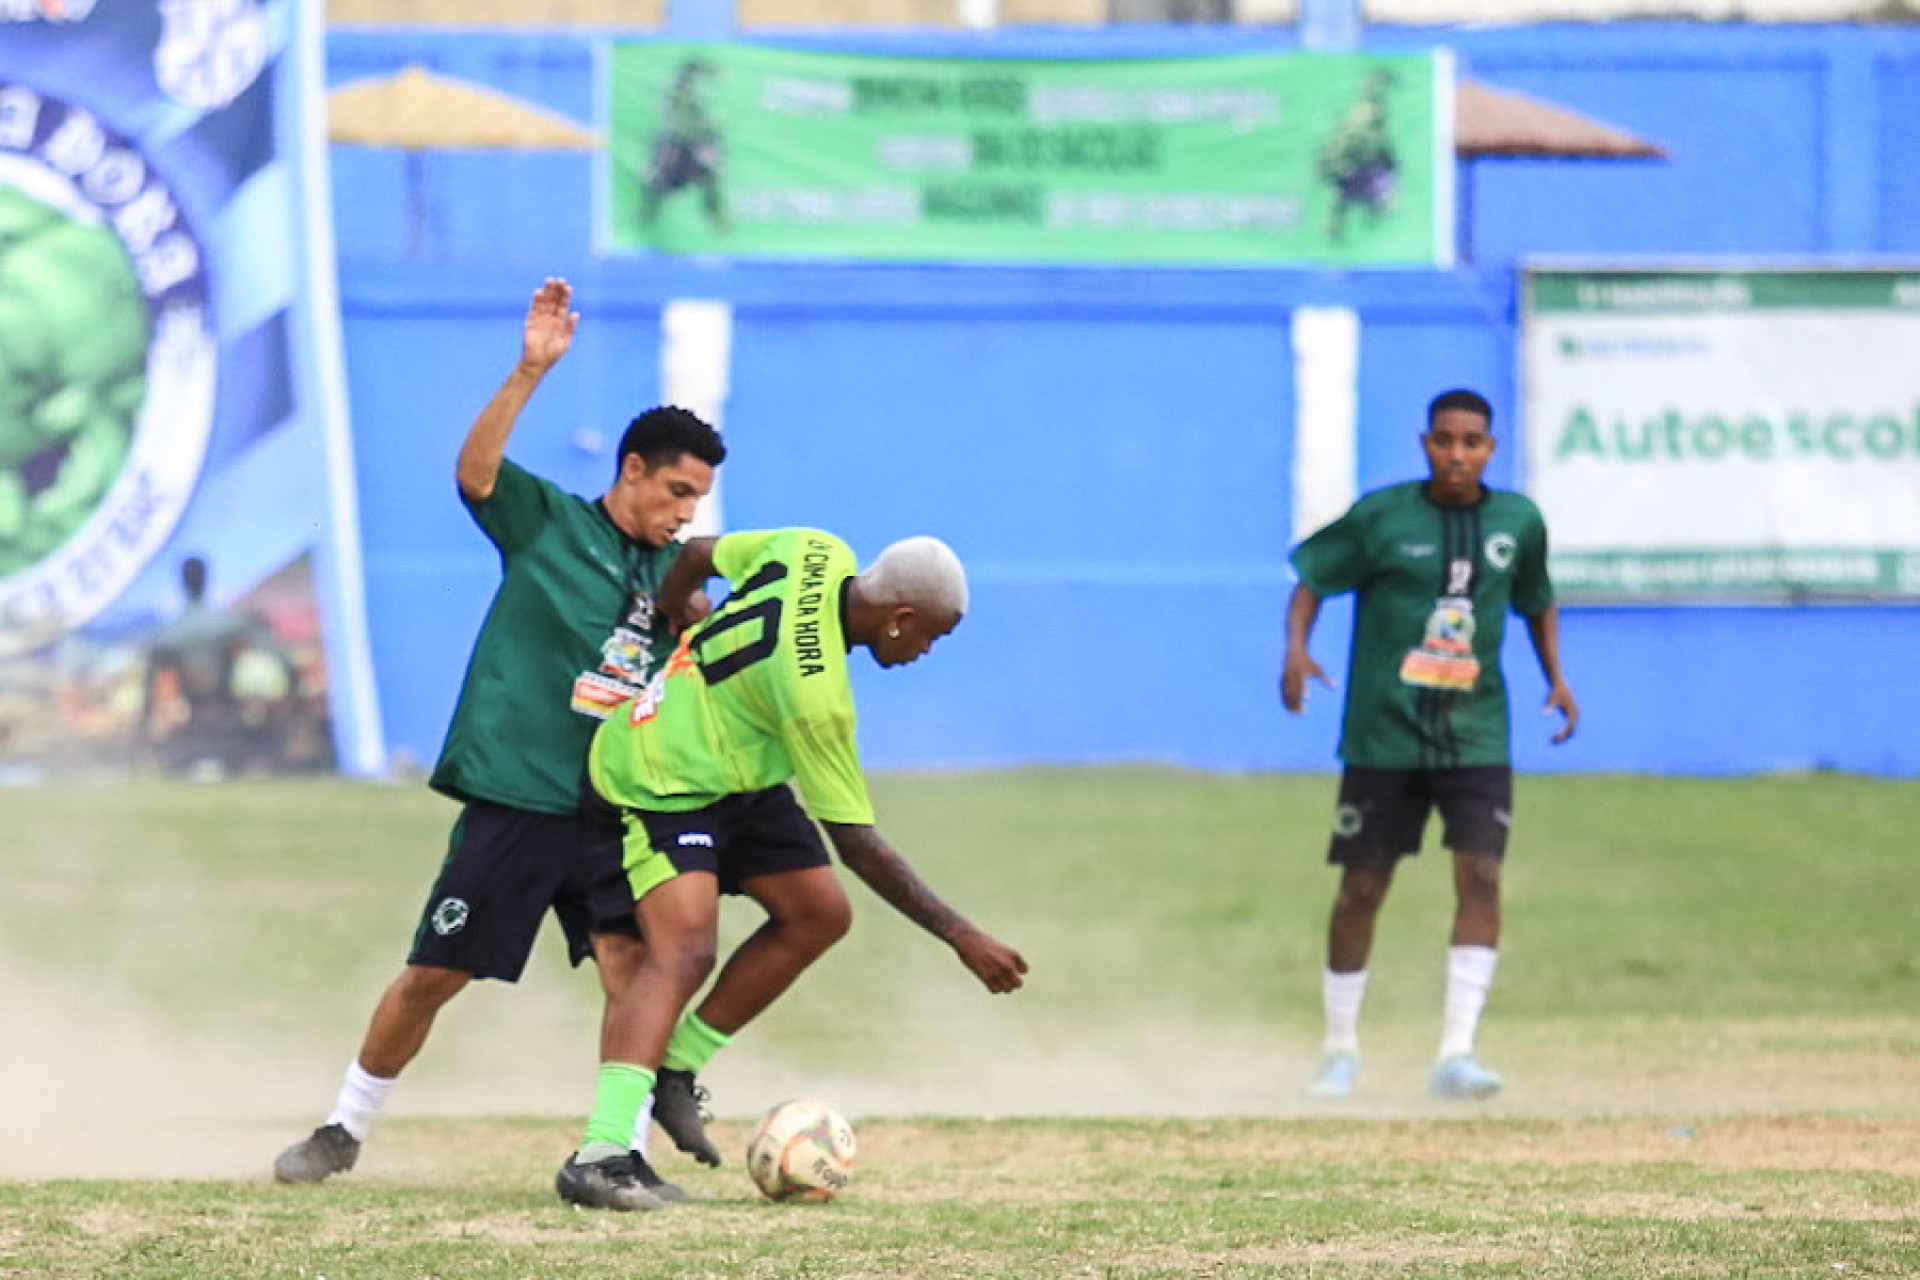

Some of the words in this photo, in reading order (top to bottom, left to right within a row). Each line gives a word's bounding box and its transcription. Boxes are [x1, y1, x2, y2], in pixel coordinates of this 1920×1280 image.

[689, 560, 787, 686] 10
[796, 593, 822, 617] DA
[794, 621, 825, 678] HORA
